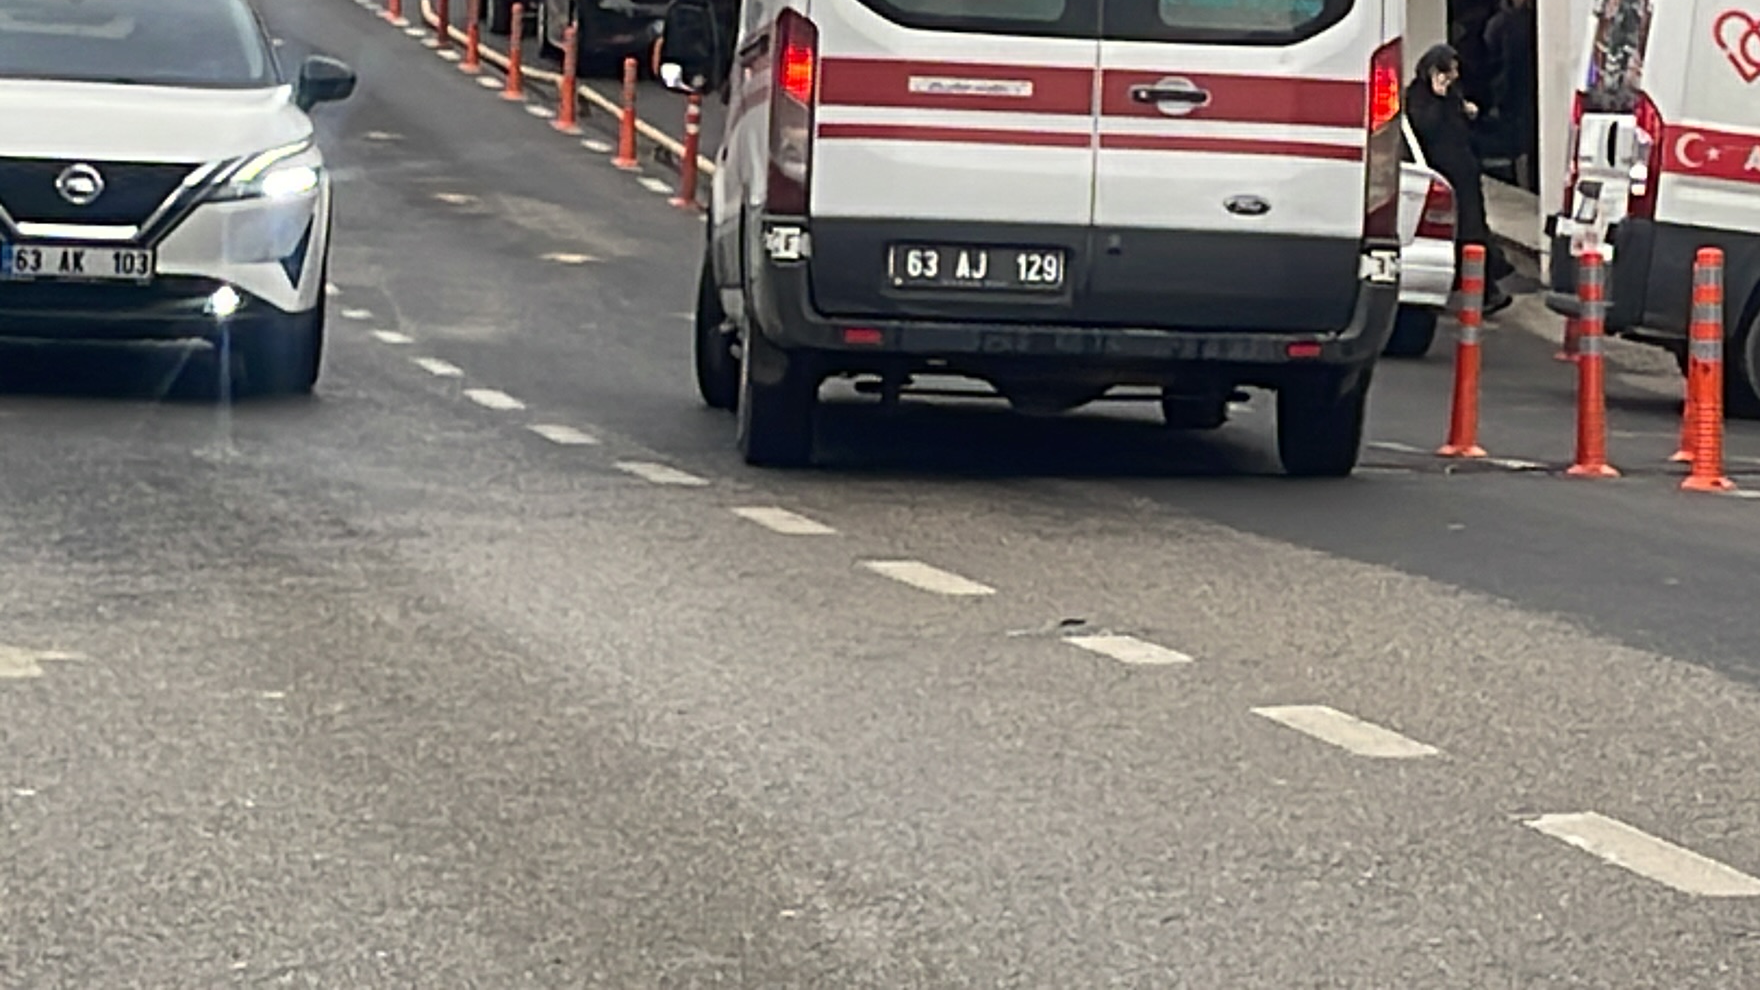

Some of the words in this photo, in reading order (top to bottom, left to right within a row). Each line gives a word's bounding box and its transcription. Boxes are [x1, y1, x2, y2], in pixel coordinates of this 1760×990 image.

[15, 249, 42, 272] 63
[58, 250, 85, 273] AK
[112, 250, 148, 275] 103
[906, 249, 939, 278] 63
[955, 250, 988, 279] AJ
[1016, 253, 1058, 282] 129
